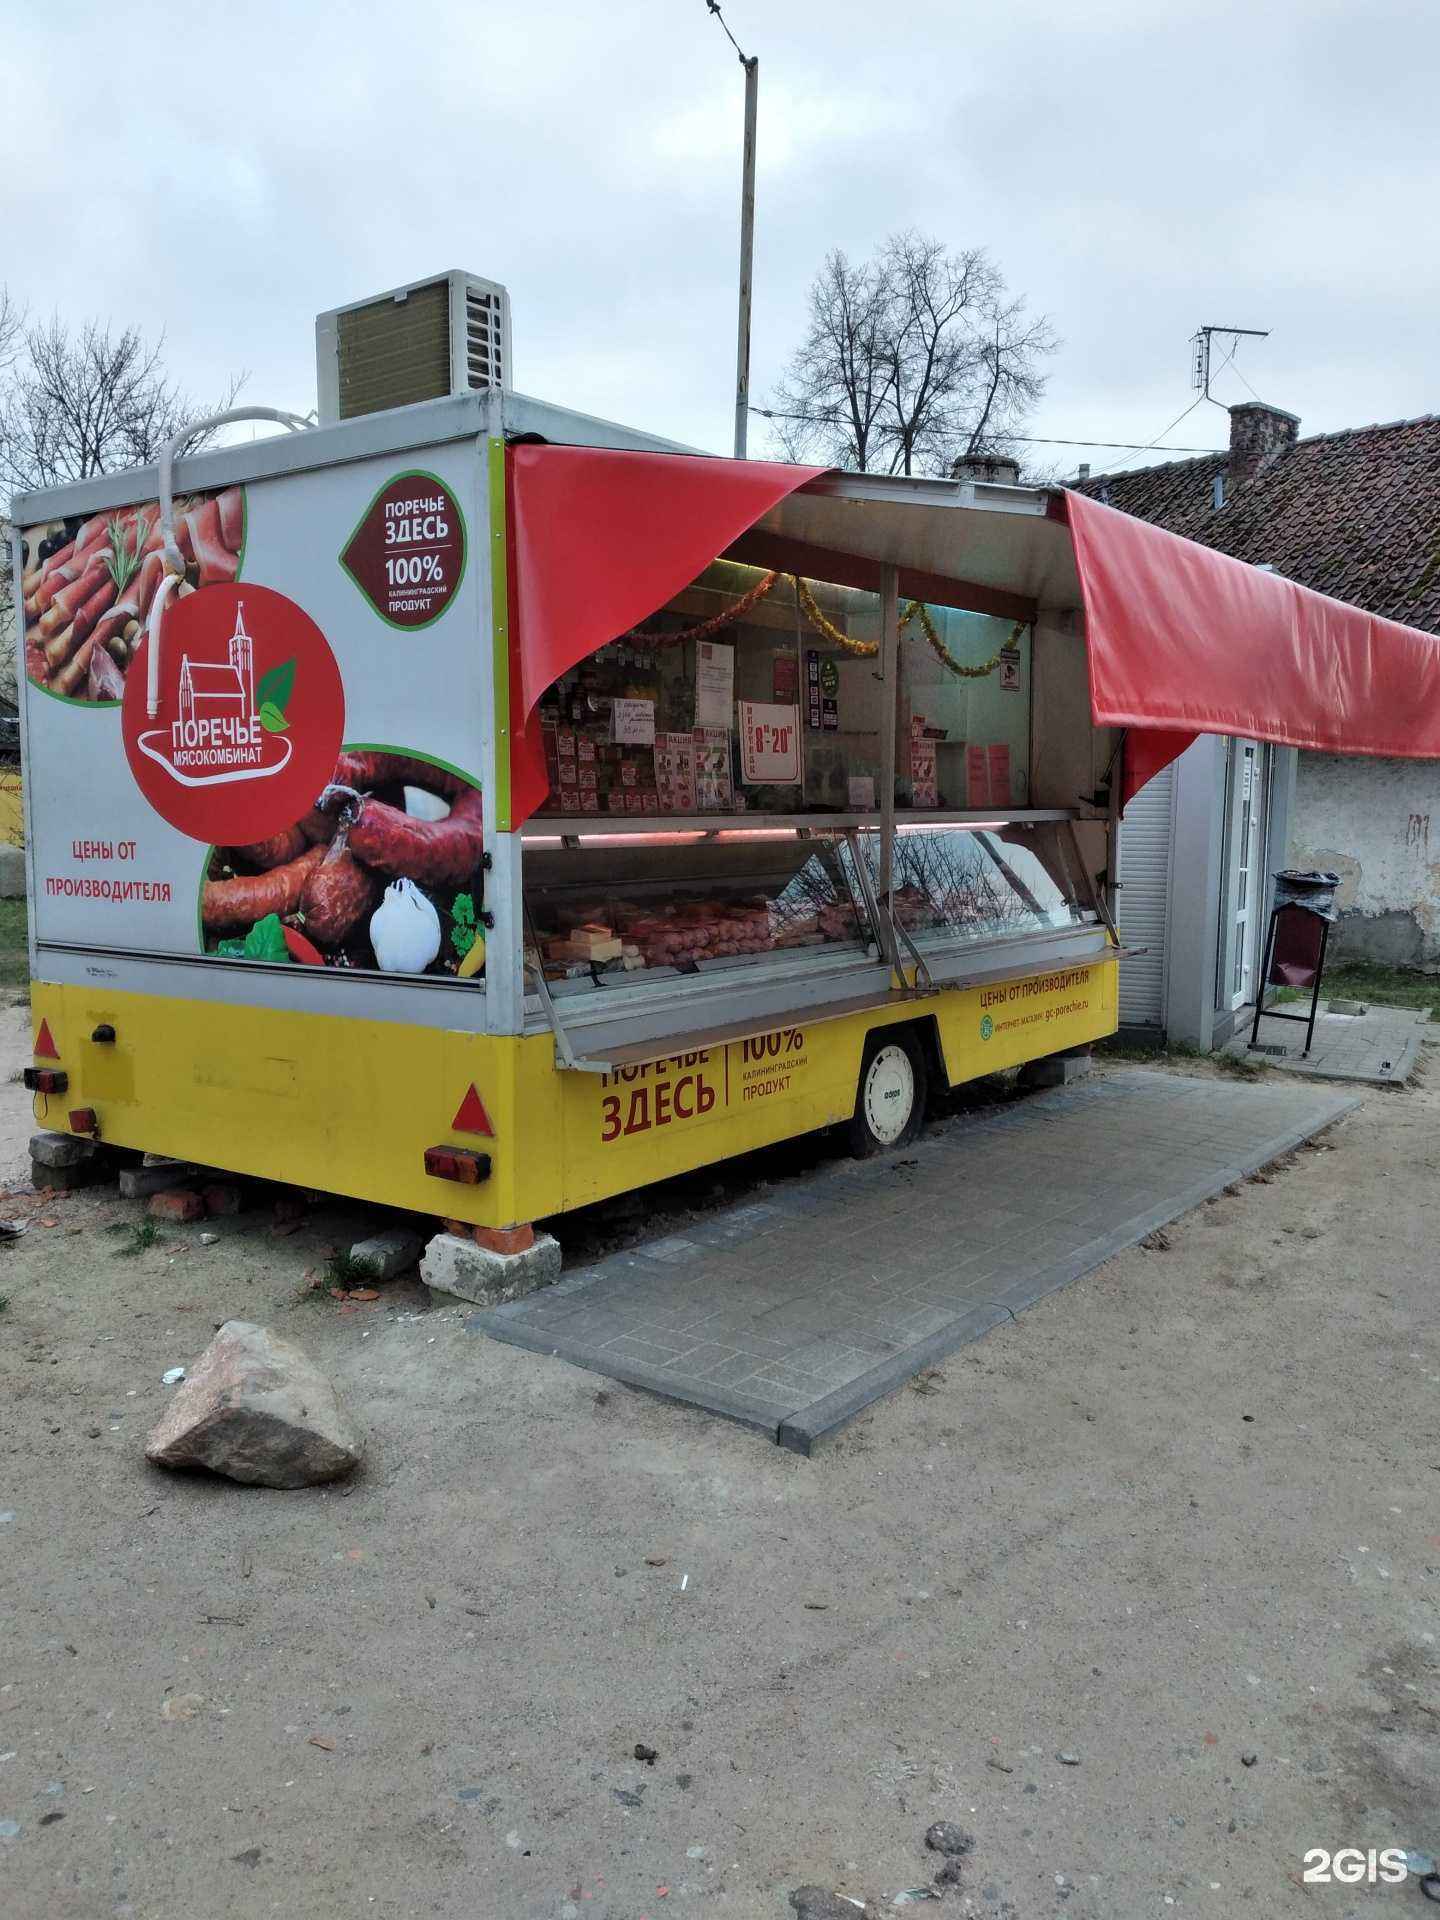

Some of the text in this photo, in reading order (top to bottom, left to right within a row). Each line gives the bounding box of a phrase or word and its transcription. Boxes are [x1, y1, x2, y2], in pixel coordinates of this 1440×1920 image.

[385, 496, 445, 518] ПОРЕЧЬЕ
[385, 515, 449, 544] ЗДЕСЬ
[385, 554, 443, 585] 100%
[388, 586, 447, 598] КАЛИНИНГРАДСКИЙ
[388, 599, 432, 612] ПРОДУКТ
[171, 715, 262, 748] ПОРЕЧЬЕ
[173, 747, 262, 766] МЯСОКОМБИНАТ
[72, 840, 137, 863] ЦЕНЫ ОТ
[46, 877, 171, 903] ПРОИЗВОДИТЕЛЯ
[980, 969, 1089, 1009] ЦЕНЫ ОТ ПРОИЗВОДИТЕЛЯ
[743, 1055, 808, 1081] КАЛИНИНГРАДСКИЙ
[743, 1075, 791, 1101] ПРОДУКТ
[601, 1073, 715, 1142] ЗДЕСЬ
